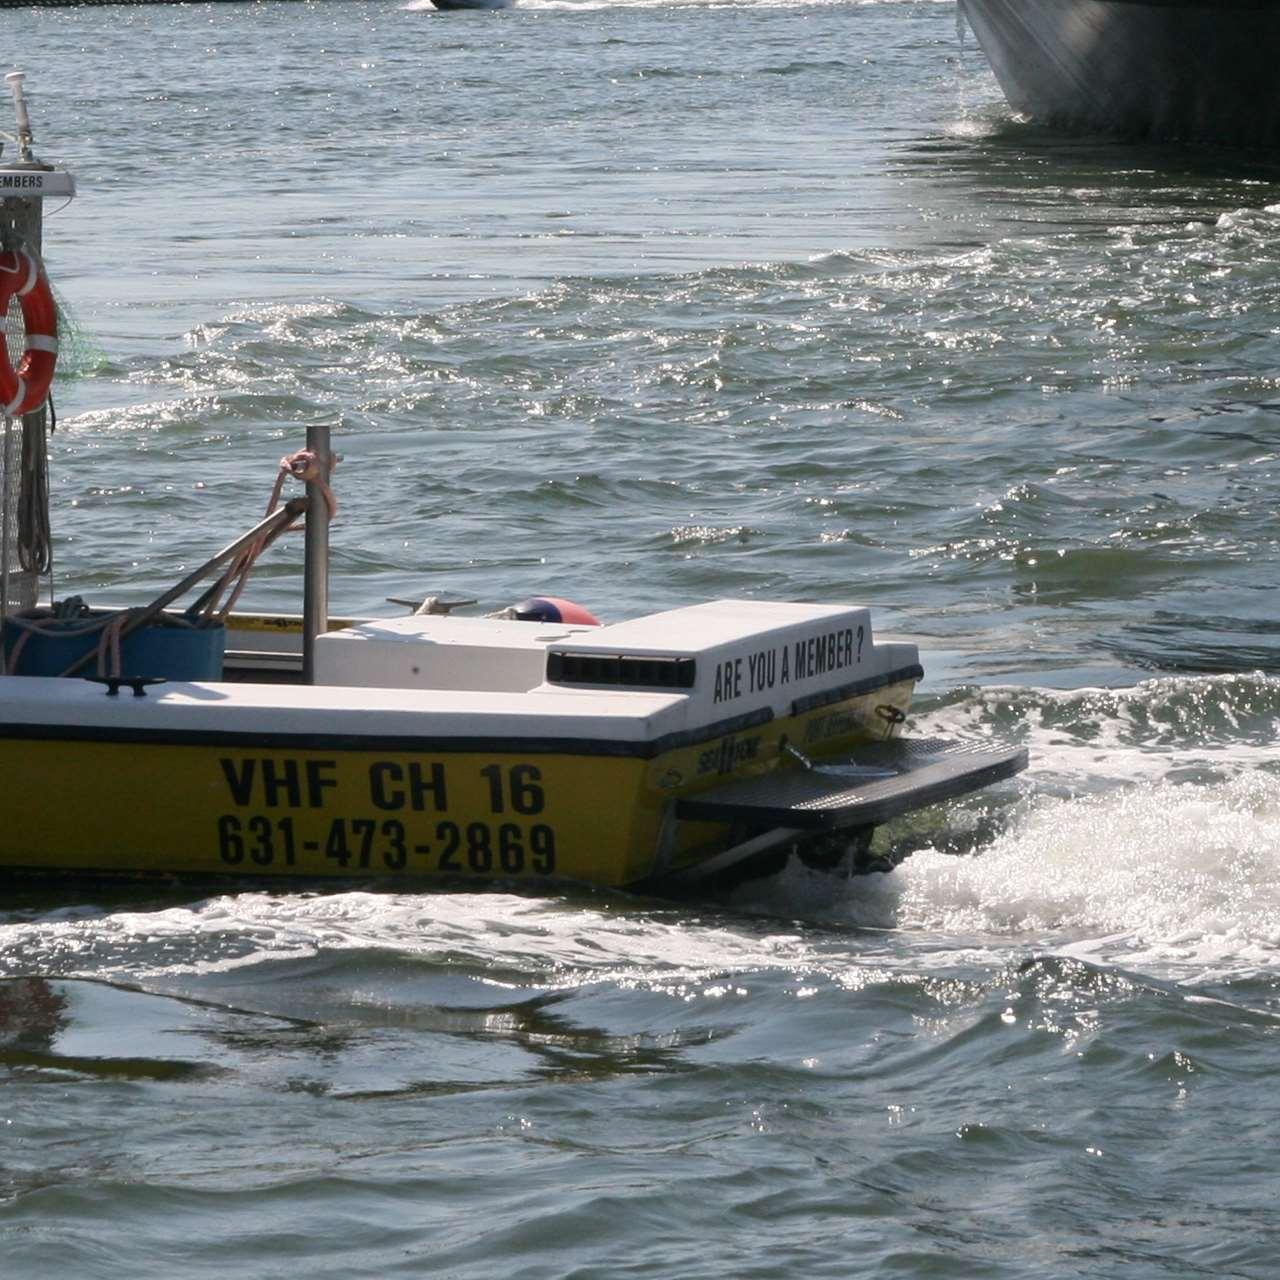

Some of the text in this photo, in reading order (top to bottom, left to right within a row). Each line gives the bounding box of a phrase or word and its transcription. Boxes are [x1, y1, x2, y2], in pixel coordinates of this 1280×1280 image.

[713, 657, 742, 704] ARE
[748, 651, 776, 693] YOU
[780, 645, 789, 684] A
[220, 758, 546, 816] VHF CH 16
[218, 815, 556, 875] 631-473-2869
